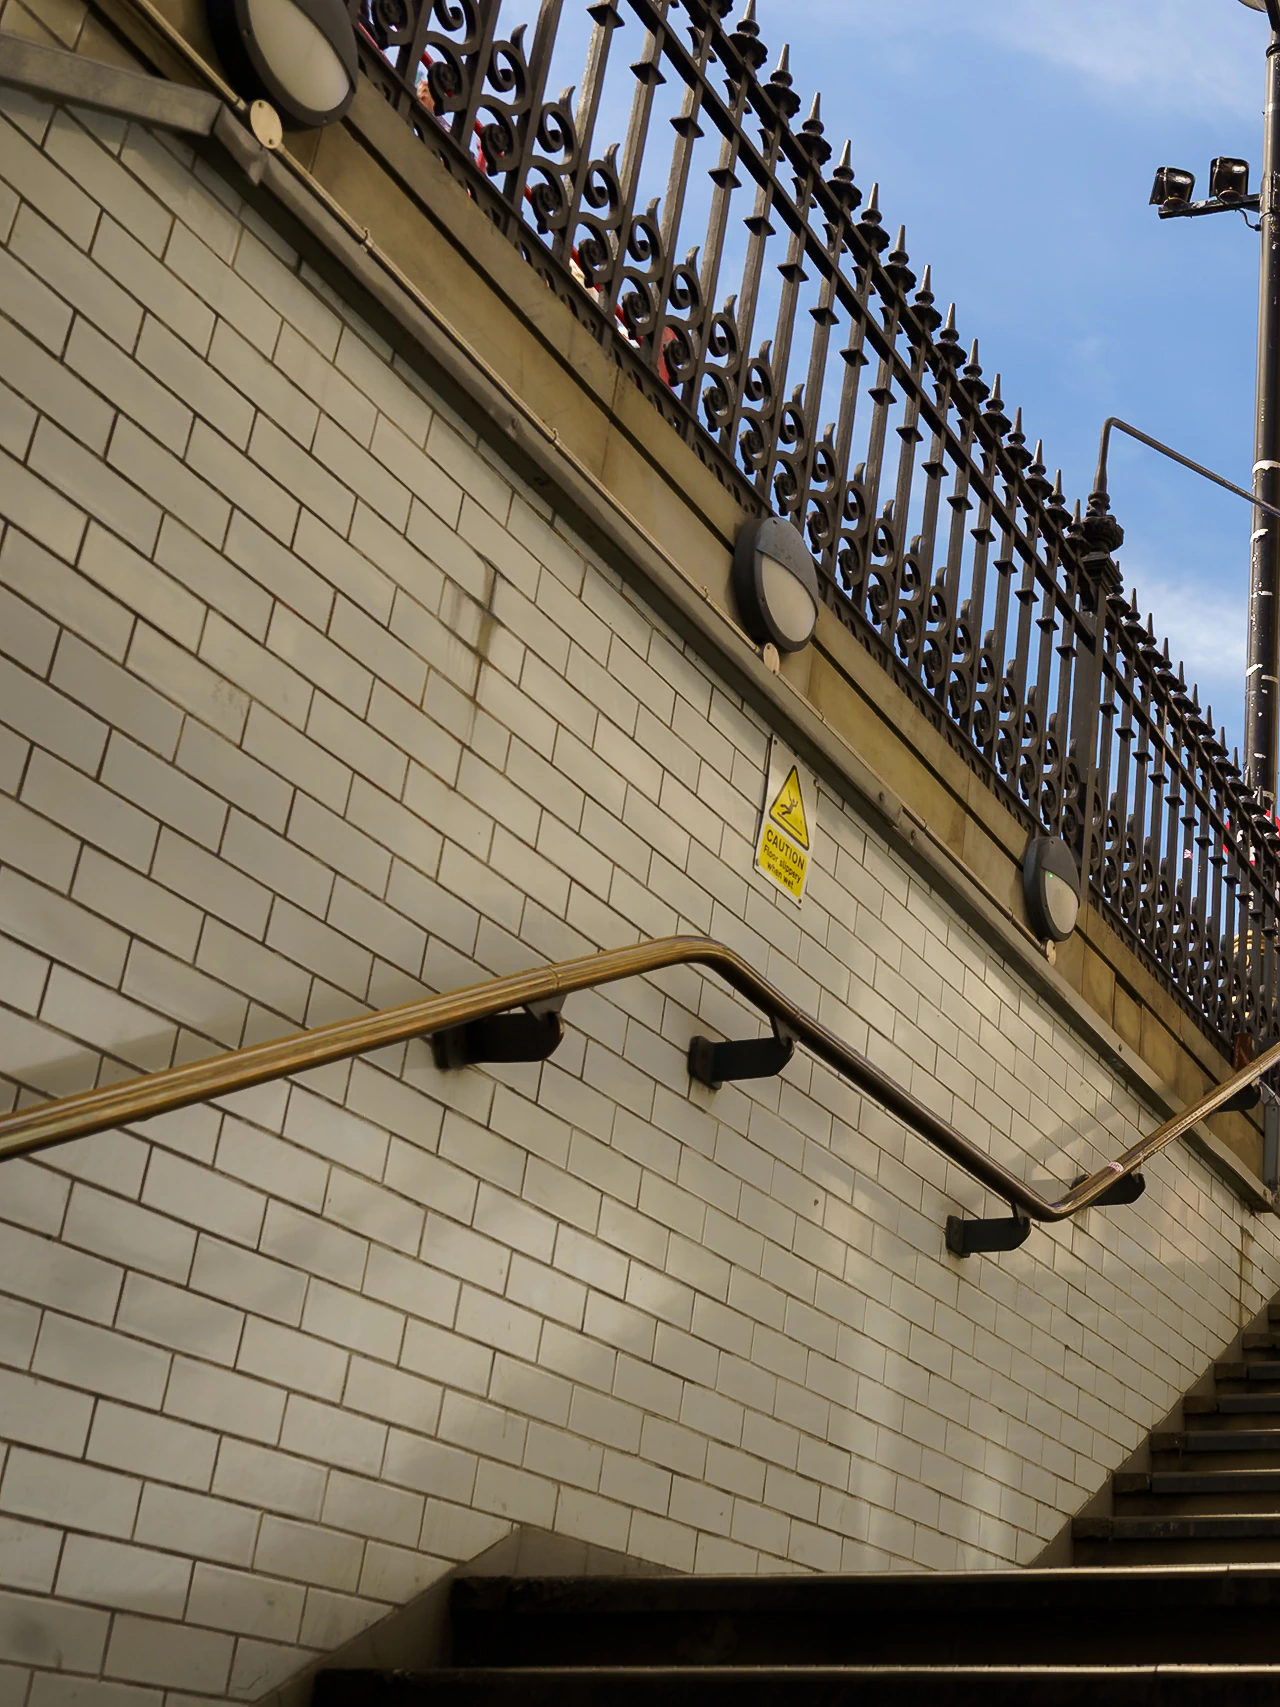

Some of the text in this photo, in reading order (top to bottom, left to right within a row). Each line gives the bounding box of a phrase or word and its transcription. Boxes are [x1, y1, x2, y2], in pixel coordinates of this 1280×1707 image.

[763, 844, 802, 884] Floor slippery
[766, 829, 805, 871] CAUTION
[767, 861, 794, 890] when wet
